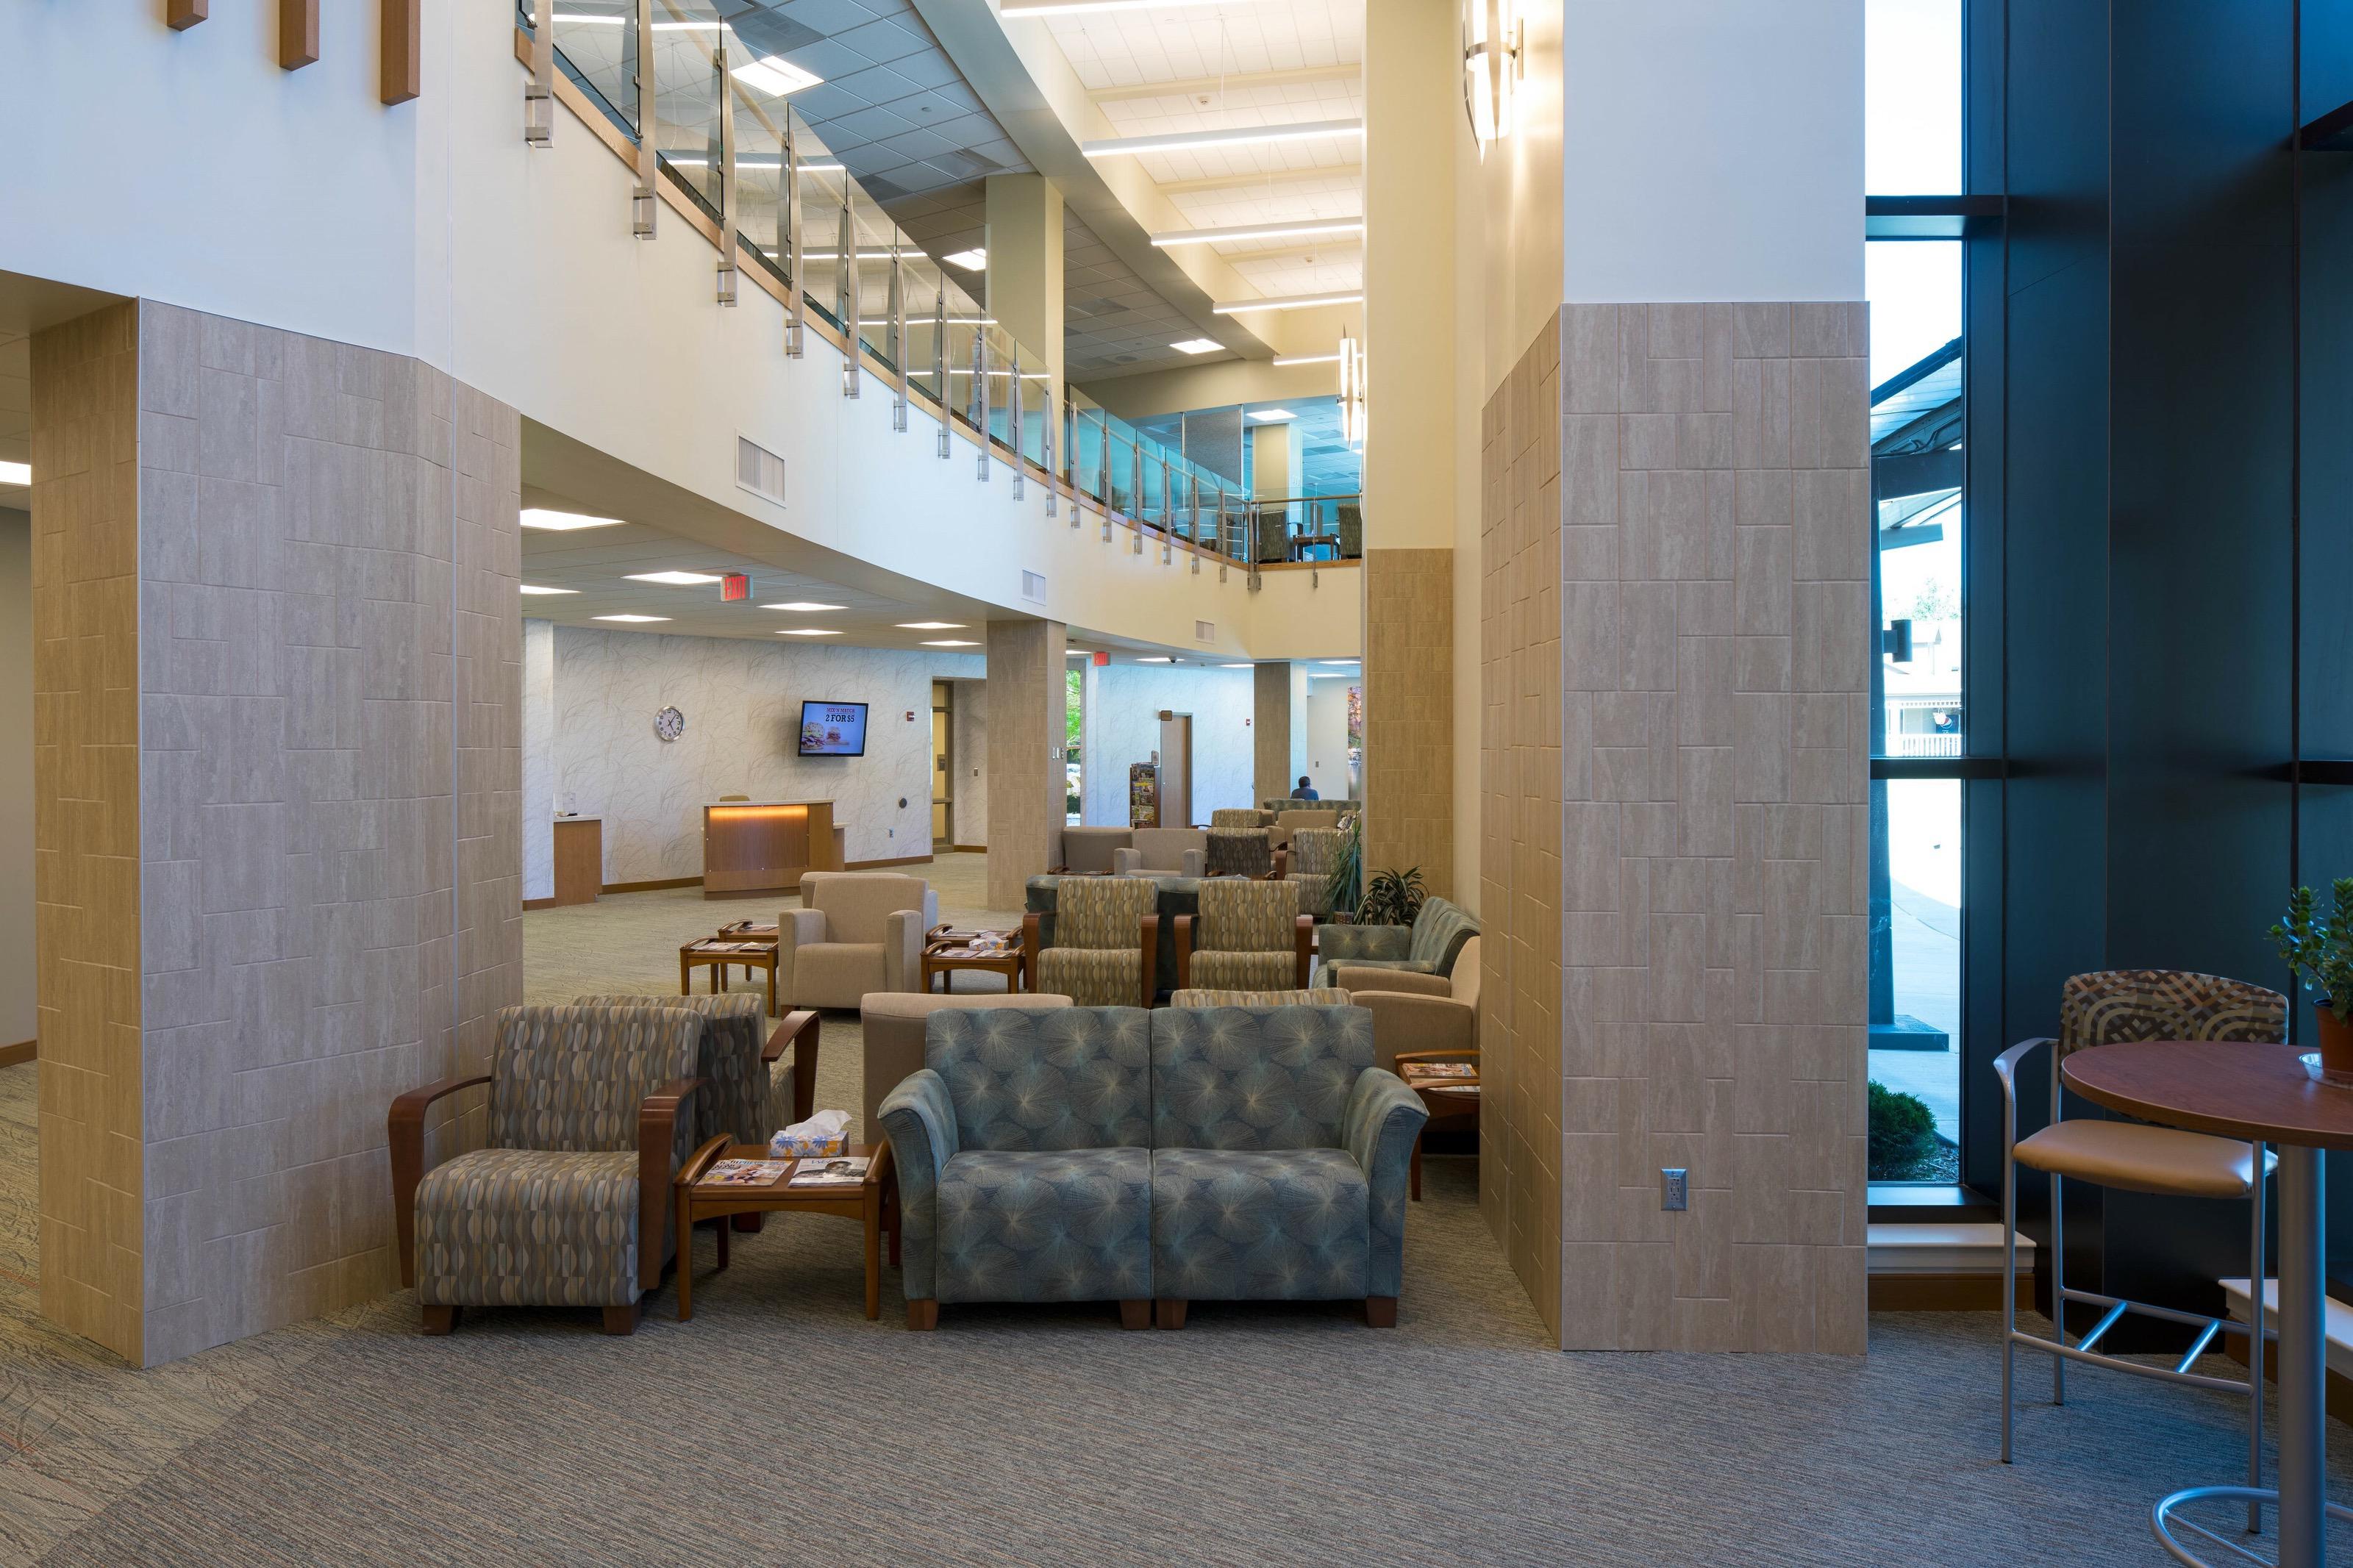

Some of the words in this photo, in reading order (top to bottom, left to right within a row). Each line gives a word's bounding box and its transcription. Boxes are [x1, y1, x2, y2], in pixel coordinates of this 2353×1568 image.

[725, 576, 746, 600] EXIT
[825, 714, 829, 722] 2
[831, 714, 846, 723] FOR
[847, 715, 854, 723] $5
